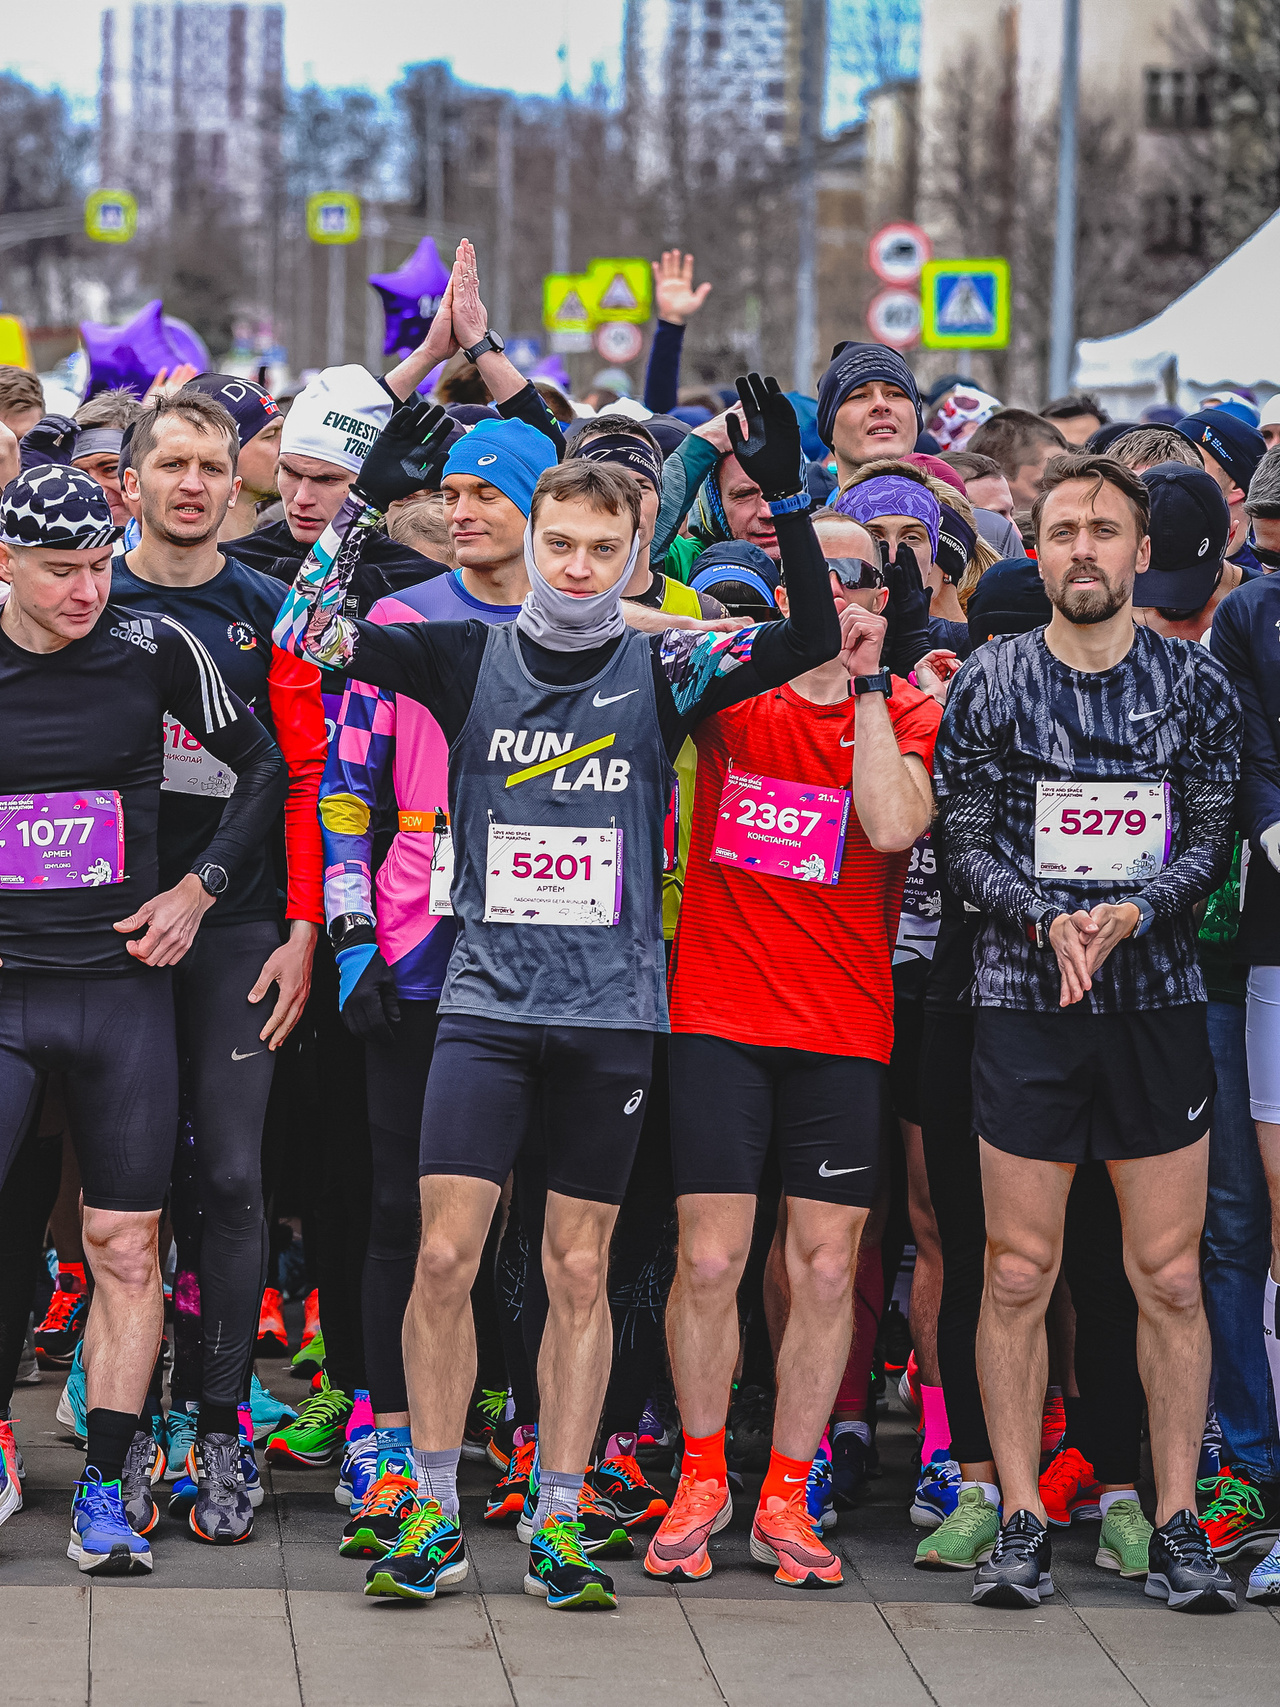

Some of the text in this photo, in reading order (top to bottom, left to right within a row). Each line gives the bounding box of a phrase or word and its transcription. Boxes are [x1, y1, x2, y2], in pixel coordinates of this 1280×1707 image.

[109, 626, 159, 655] adidas
[487, 728, 574, 764] RUN
[552, 757, 631, 793] LAB
[95, 796, 106, 804] 10
[817, 793, 833, 802] 21.1
[16, 817, 95, 847] 1077
[735, 798, 822, 837] 2367
[1059, 809, 1147, 836] 5279
[42, 849, 72, 858] АРМЕН
[747, 831, 802, 848] КОНСТАНТИН
[511, 852, 592, 881] 5201
